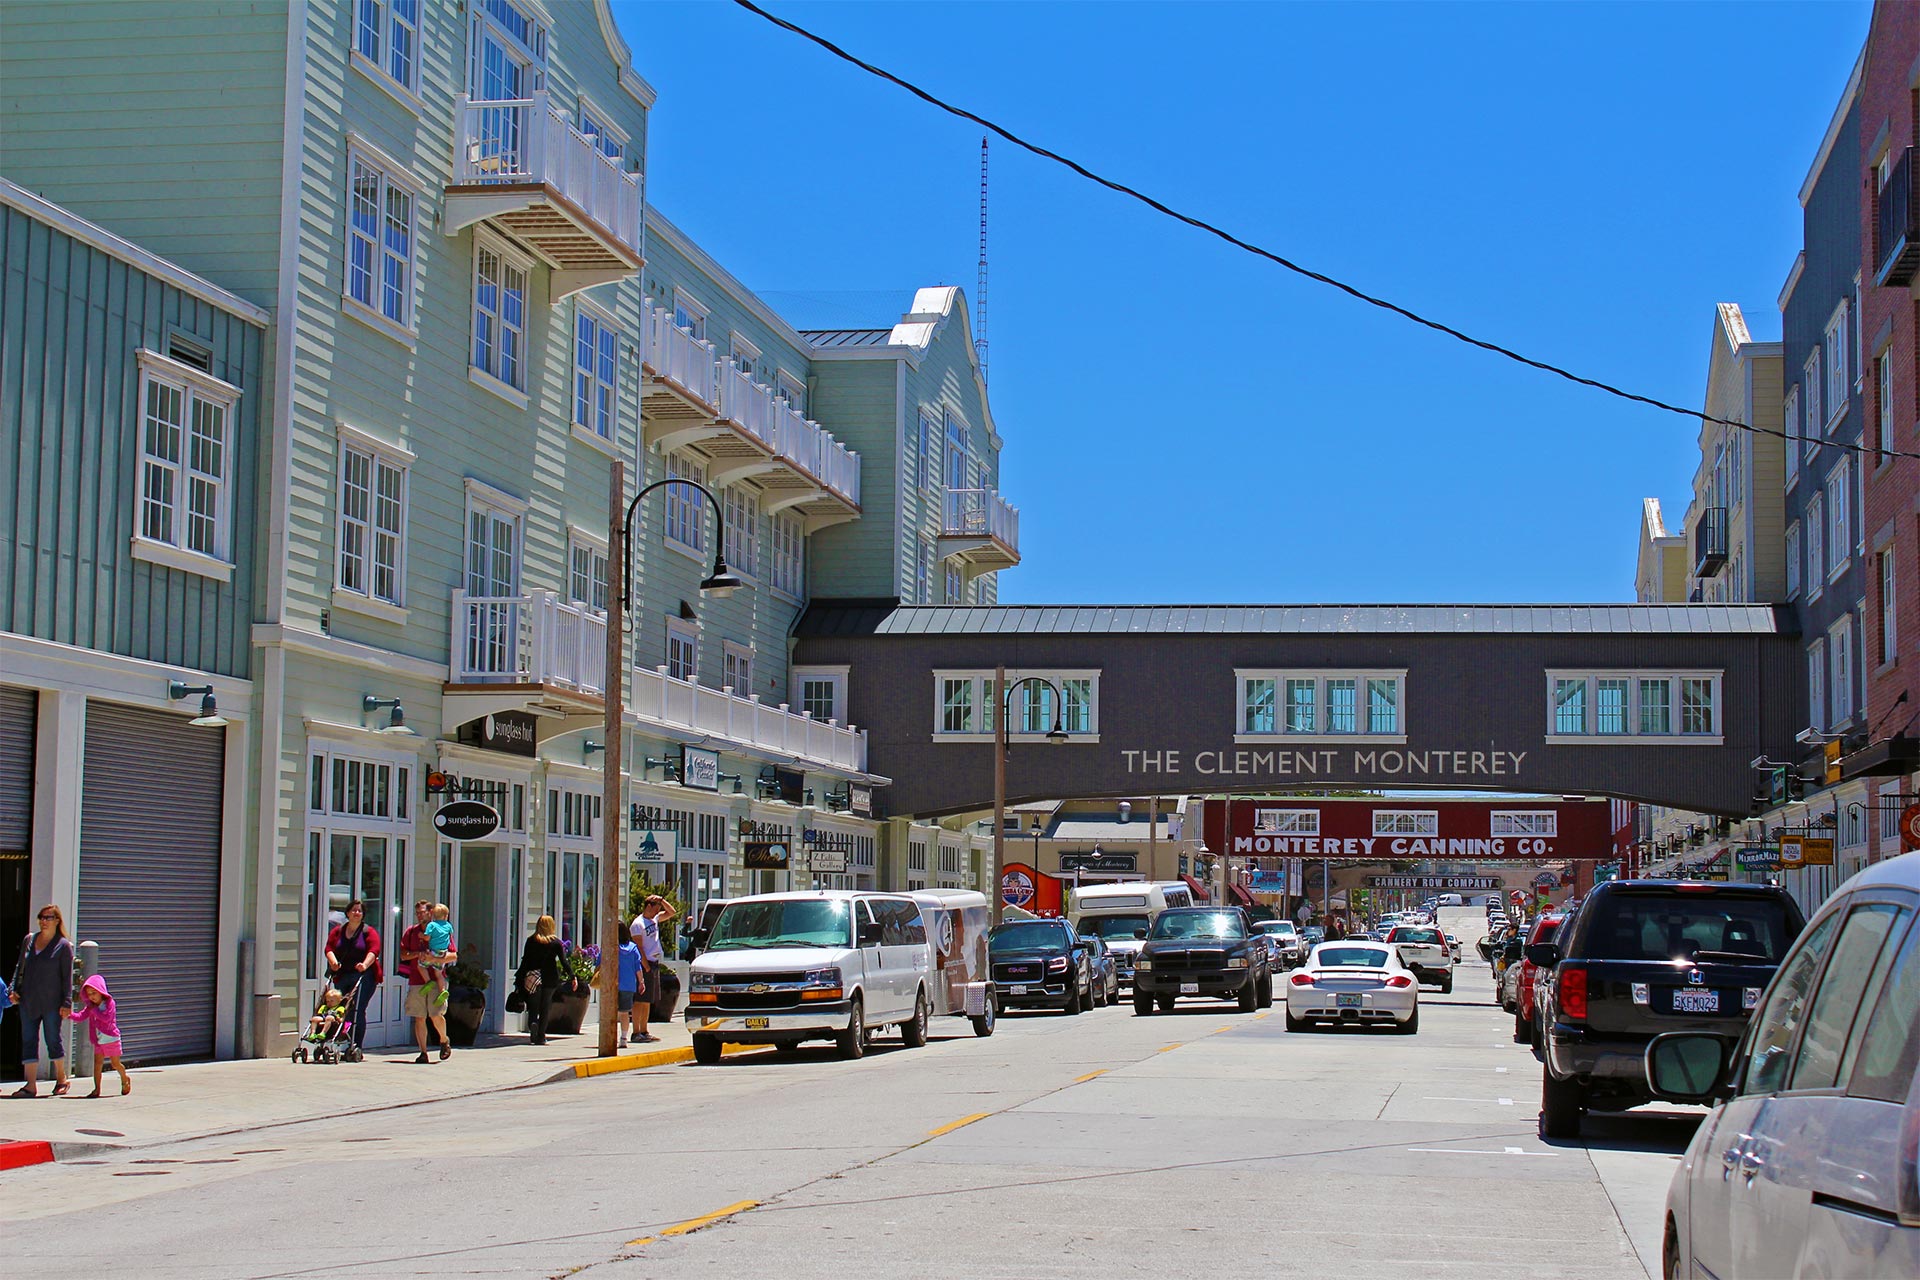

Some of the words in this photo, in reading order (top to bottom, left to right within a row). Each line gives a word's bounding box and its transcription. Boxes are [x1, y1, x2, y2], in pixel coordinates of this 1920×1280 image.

[495, 720, 522, 742] sunglass
[522, 722, 533, 742] hut
[1121, 750, 1180, 773] THE
[1194, 751, 1338, 774] CLEMENT
[1354, 750, 1528, 774] MONTEREY
[447, 815, 482, 827] sunglass
[482, 815, 496, 825] hut
[1234, 836, 1377, 855] MONTEREY
[1390, 838, 1505, 855] CANNING
[1517, 838, 1554, 855] CO.
[1066, 859, 1093, 867] Treaures
[1102, 860, 1130, 868] Monterey
[1374, 877, 1418, 887] CANNERY
[1422, 878, 1443, 887] ROW
[1447, 878, 1493, 888] COMPANY
